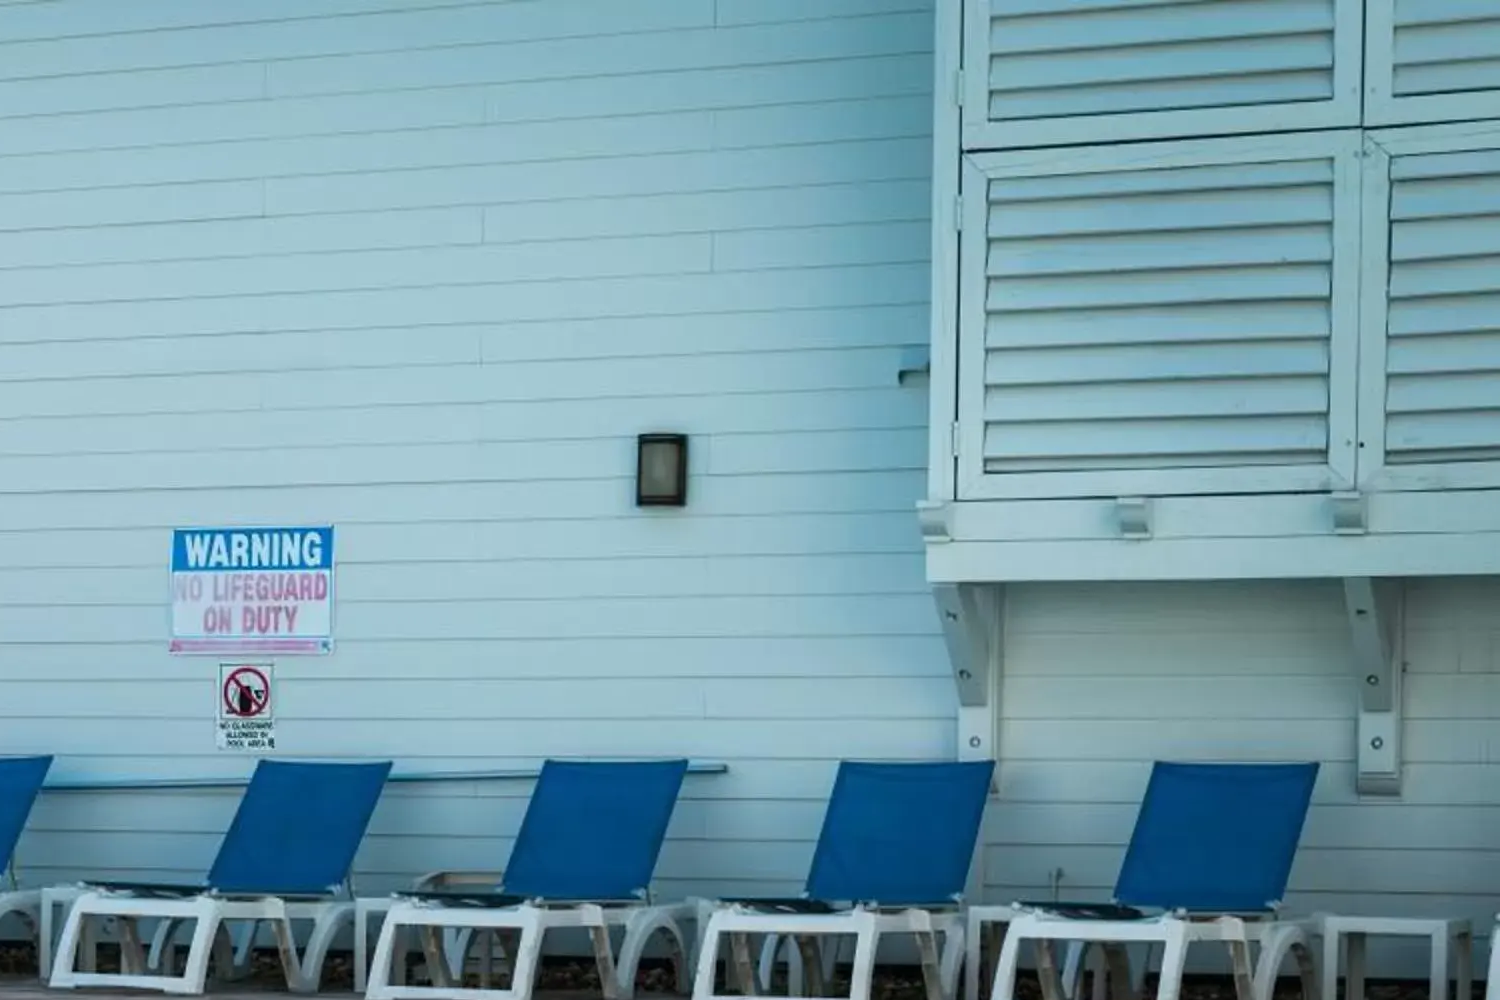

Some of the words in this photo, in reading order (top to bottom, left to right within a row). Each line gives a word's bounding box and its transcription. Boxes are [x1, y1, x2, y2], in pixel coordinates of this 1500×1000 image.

[185, 532, 322, 567] WARNING
[174, 573, 203, 601] NO
[213, 573, 328, 601] LIFEGUARD
[203, 605, 232, 633] ON
[242, 605, 298, 633] DUTY
